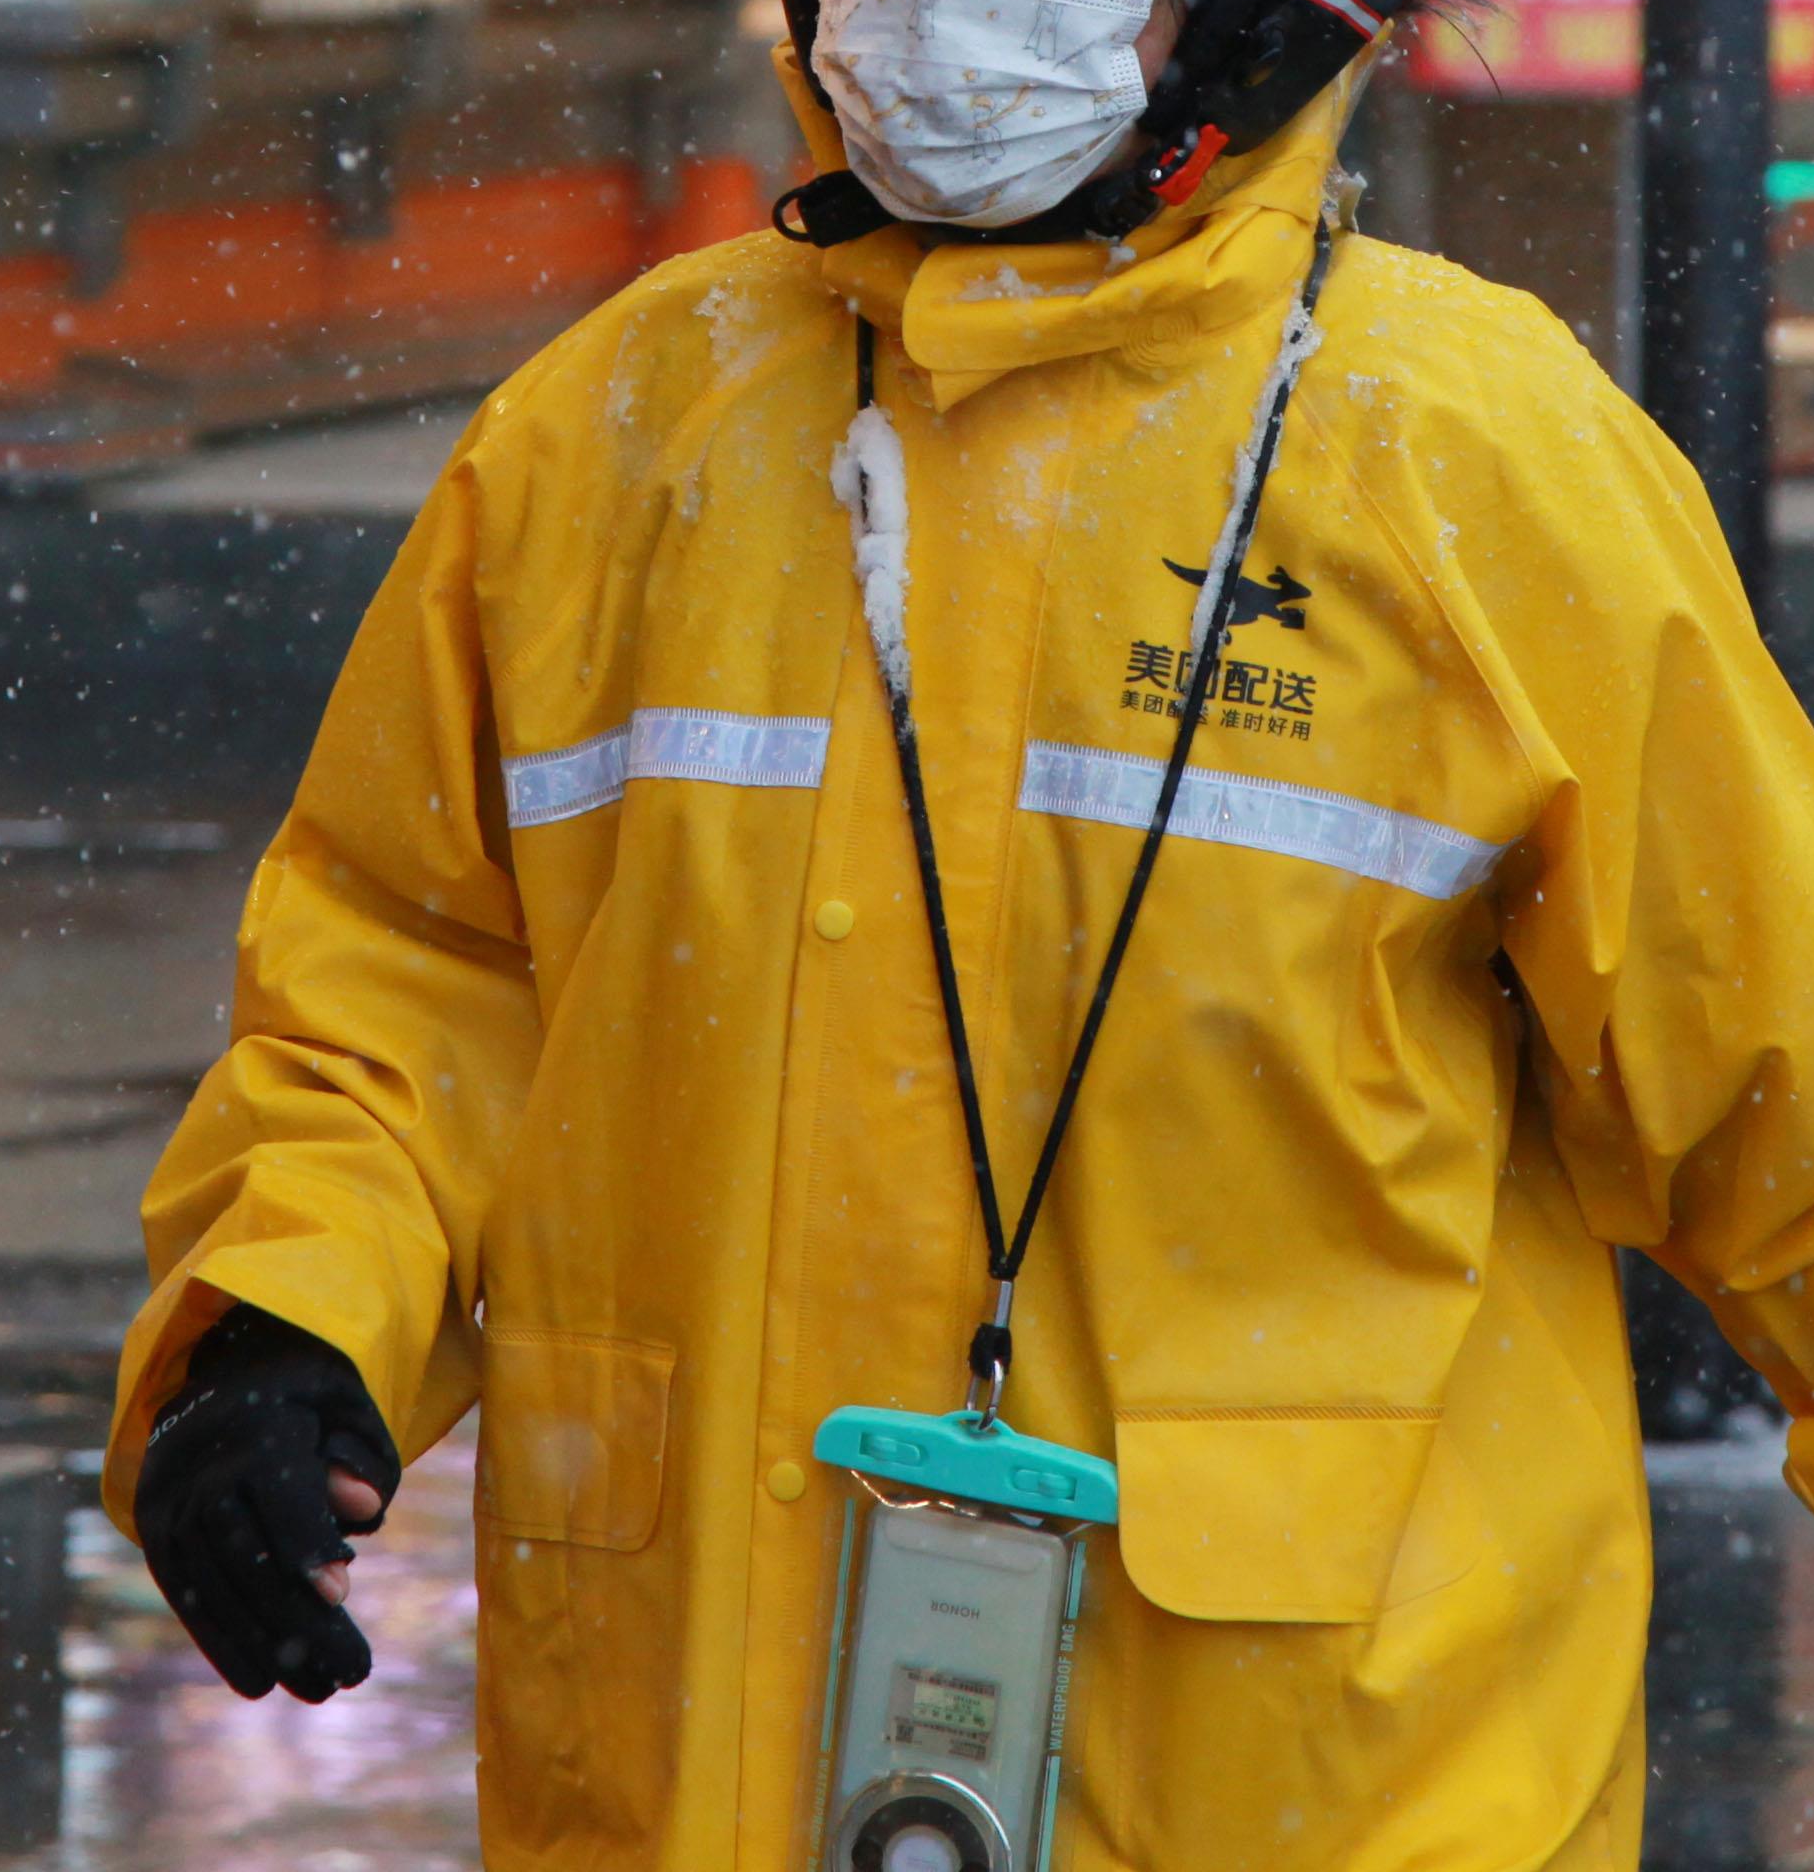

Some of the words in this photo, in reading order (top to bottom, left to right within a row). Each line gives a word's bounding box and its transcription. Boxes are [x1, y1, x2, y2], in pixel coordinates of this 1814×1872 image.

[1220, 708, 1312, 741] 准时好用
[930, 1599, 980, 1619] HONOR
[1060, 1623, 1076, 1652] BAG
[1049, 1655, 1072, 1750] WATERPROOF
